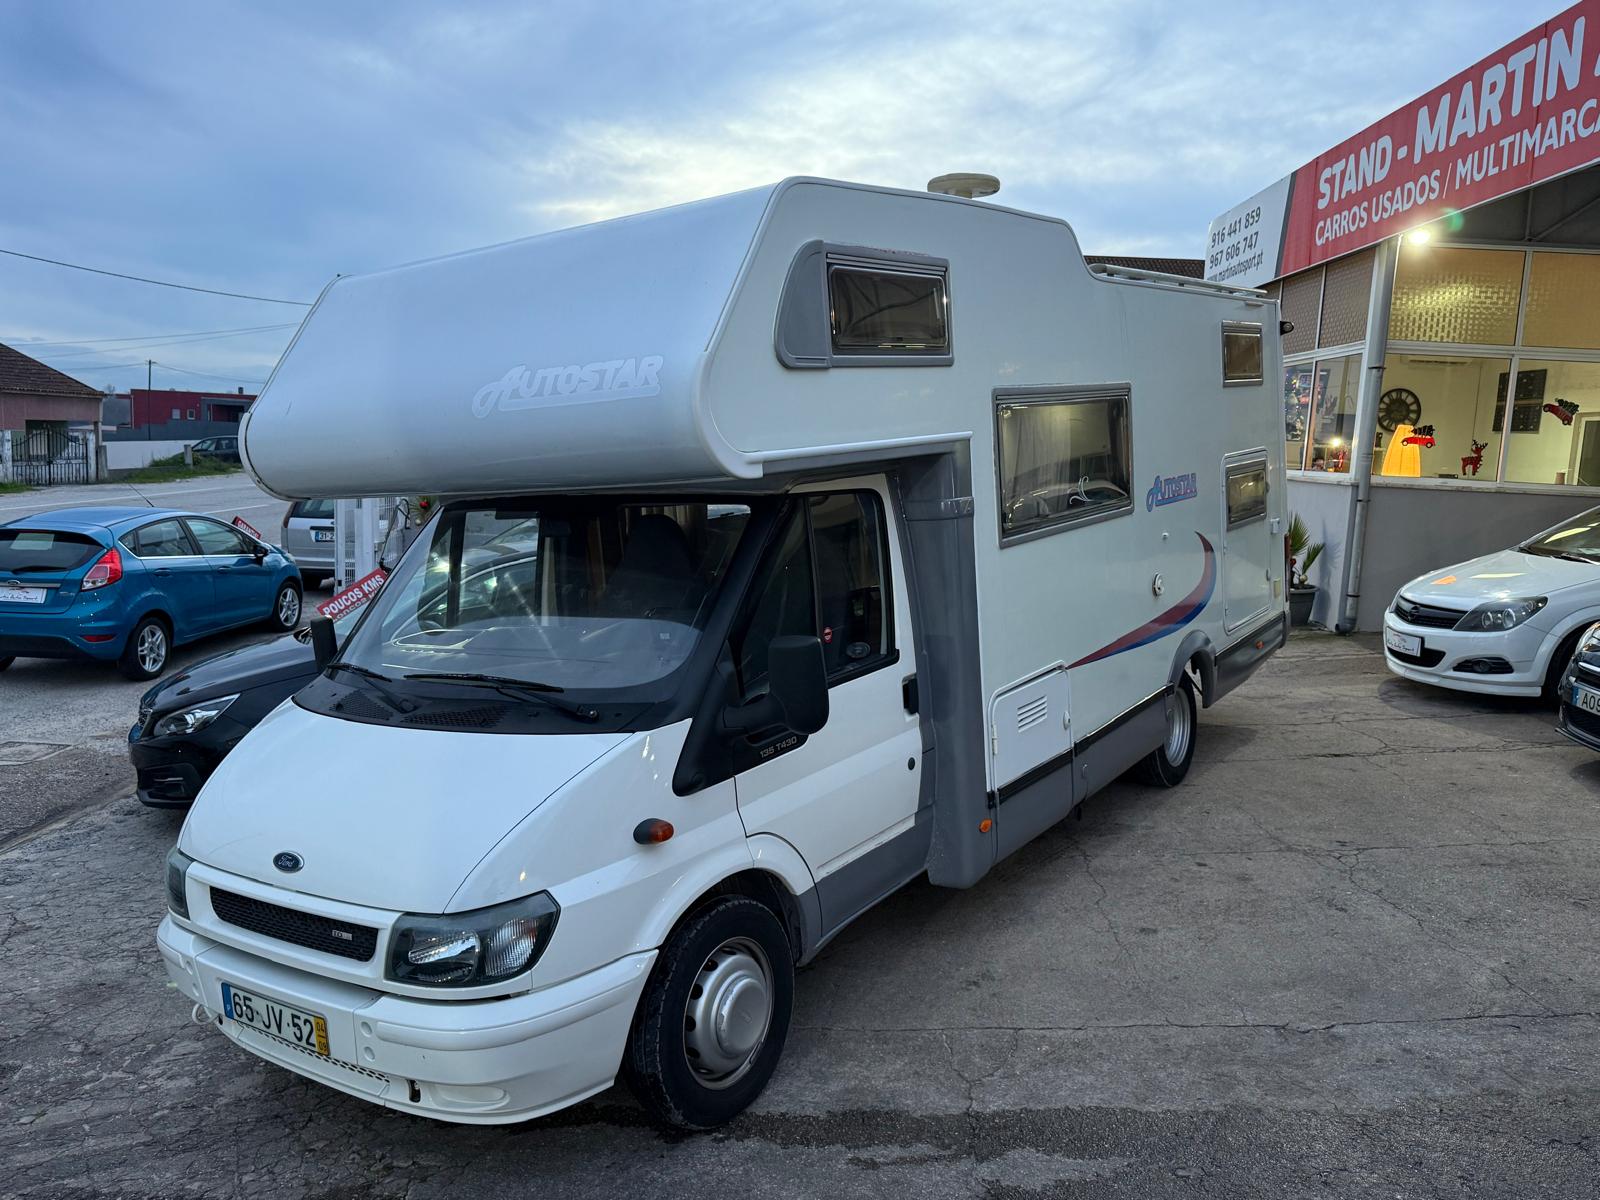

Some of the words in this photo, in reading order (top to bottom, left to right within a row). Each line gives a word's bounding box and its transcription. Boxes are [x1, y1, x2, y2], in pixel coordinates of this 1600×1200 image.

[1317, 134, 1393, 210] STAND
[1413, 15, 1586, 164] MARTIN
[1315, 201, 1368, 247] CARROS
[1371, 169, 1441, 223] USADOS
[1455, 98, 1600, 190] MULTIMARC
[1211, 226, 1226, 249] 916
[1227, 216, 1242, 238] 441
[1244, 206, 1261, 229] 859
[1209, 249, 1224, 269] 967
[1225, 240, 1241, 261] 606
[1243, 230, 1259, 254] 747
[471, 355, 664, 419] AUTOSTAR
[1146, 472, 1197, 512] AUTOSTAR
[322, 587, 363, 615] POUCOS
[361, 574, 385, 594] KMS
